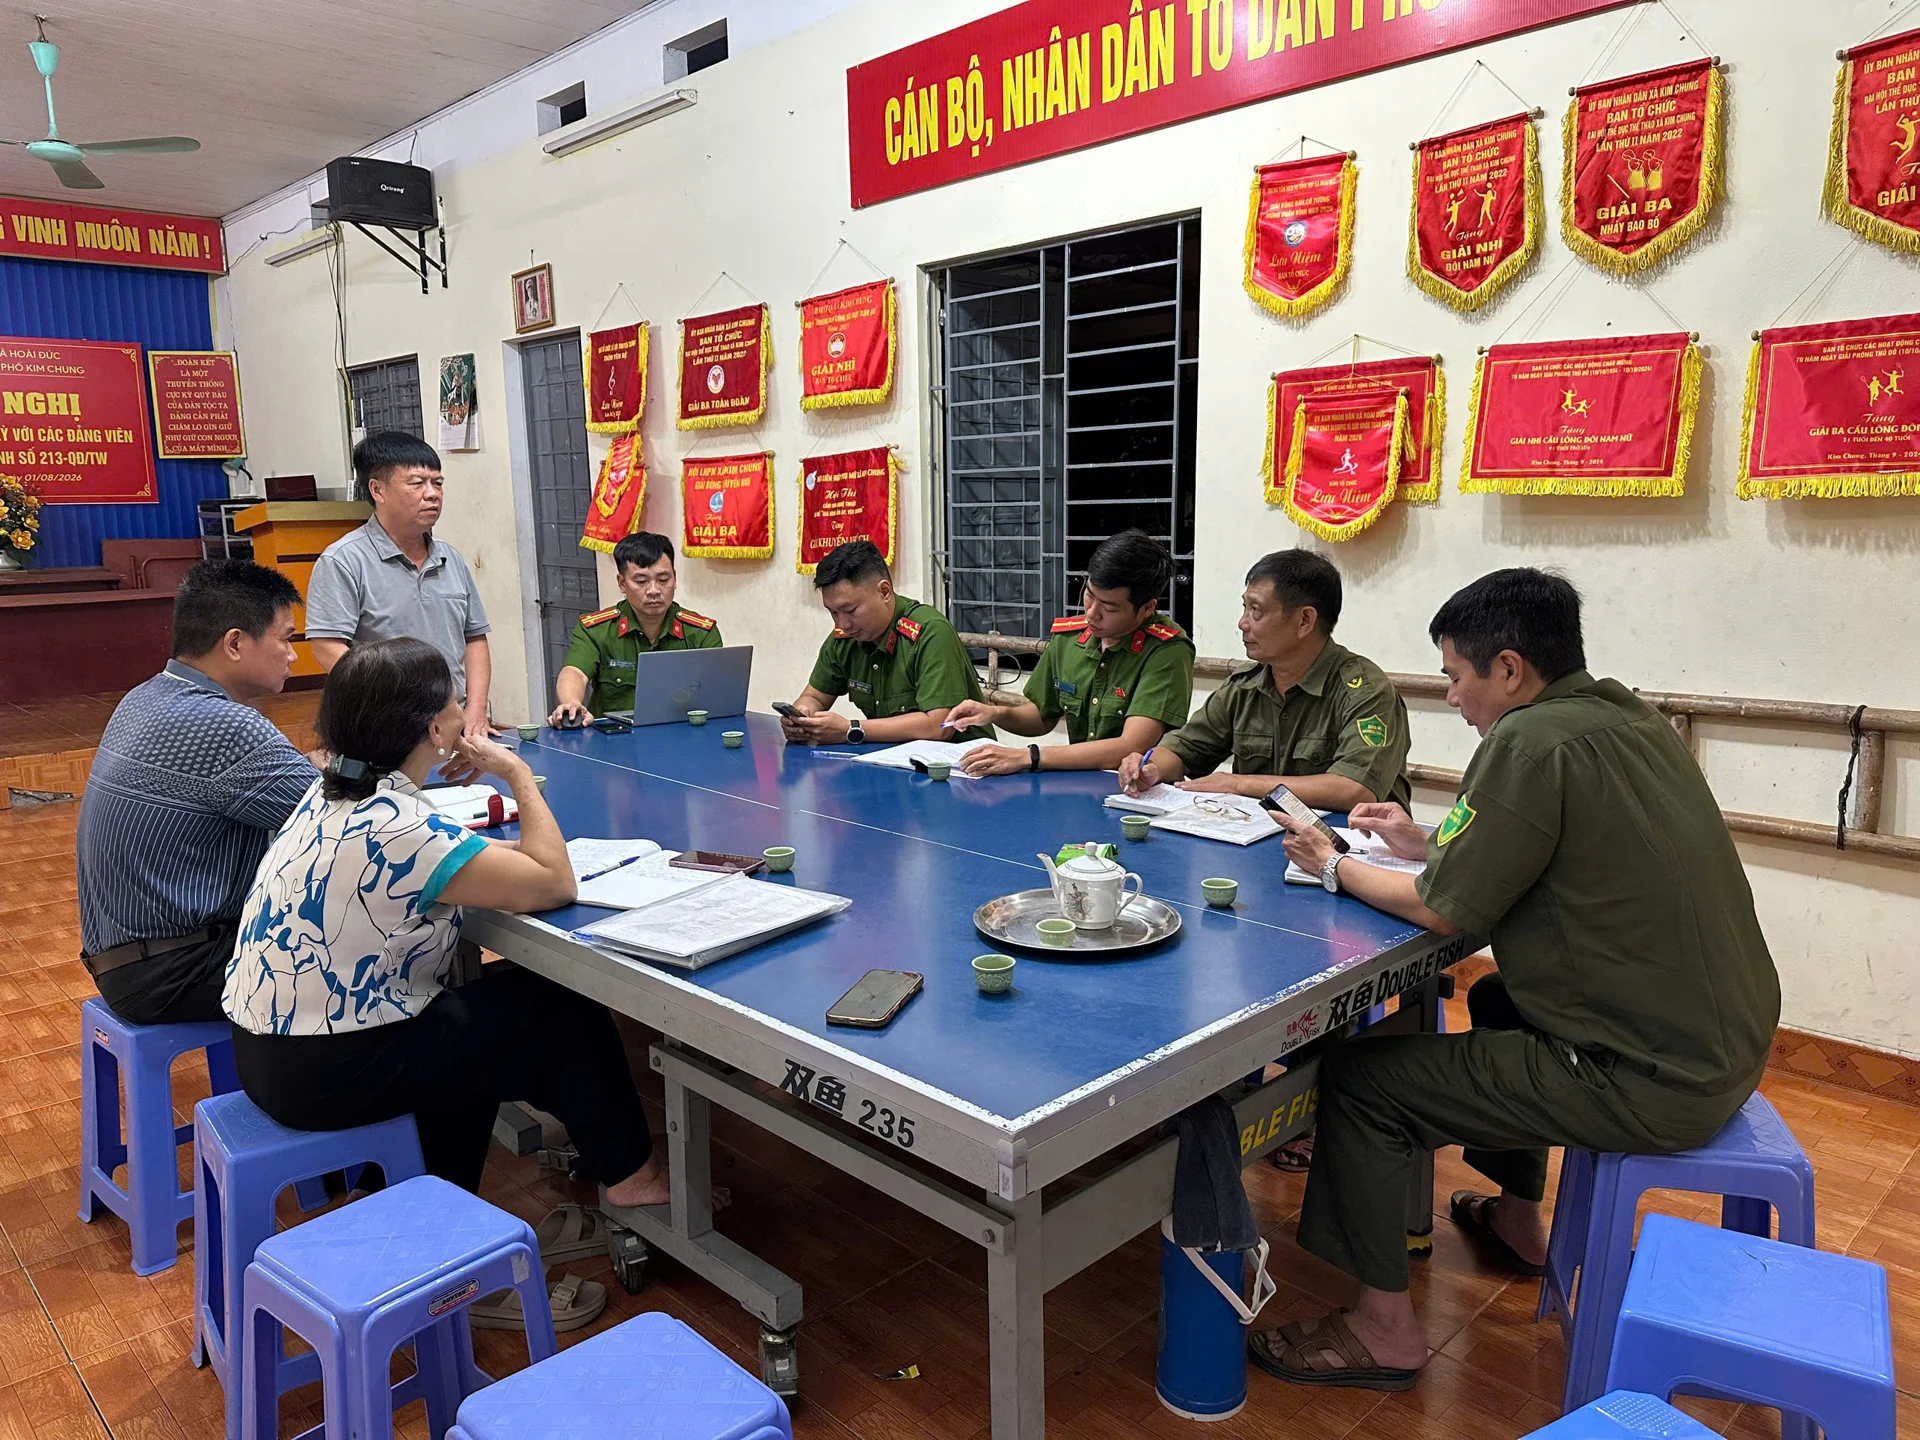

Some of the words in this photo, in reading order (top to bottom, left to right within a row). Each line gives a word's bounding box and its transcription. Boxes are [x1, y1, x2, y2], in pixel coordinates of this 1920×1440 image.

[1864, 61, 1874, 74] ỦY
[1876, 57, 1893, 70] BAN
[1896, 49, 1919, 65] NHÂN
[885, 76, 938, 165] CÁN
[947, 54, 993, 158] BỘ,
[1003, 26, 1090, 132] NHÂN
[1102, 0, 1175, 104] DÂN
[1887, 67, 1915, 84] BAN
[1598, 98, 1611, 108] BAN
[1613, 94, 1632, 106] NHÂN
[1634, 90, 1647, 102] DÂN
[1660, 86, 1672, 96] KIM
[1674, 80, 1699, 94] CHUNG
[1903, 83, 1917, 94] DỤC
[1607, 110, 1628, 123] BAN
[1632, 103, 1644, 118] TỔ
[1648, 100, 1676, 116] CHỨC
[1641, 120, 1655, 130] THAO
[1665, 116, 1675, 126] KIM
[1677, 112, 1696, 123] CHUNG
[1463, 142, 1474, 152] DÂN
[1484, 135, 1495, 146] KIM
[1497, 129, 1516, 143] CHUNG
[1615, 135, 1630, 148] THỨ
[1640, 131, 1660, 145] NĂM
[1663, 128, 1683, 140] 2022
[1442, 158, 1458, 170] BAN
[1462, 152, 1471, 163] TỔ
[1476, 146, 1499, 160] CHỨC
[1470, 173, 1487, 184] NĂM
[1489, 168, 1507, 179] 2022
[1877, 182, 1916, 206] GIẢI
[1596, 201, 1637, 219] GIẢI
[1644, 198, 1672, 212] BA
[1627, 220, 1644, 231] BAO
[11, 215, 67, 245] VINH
[75, 218, 140, 252] MUÔN
[149, 224, 199, 257] NĂM
[1441, 245, 1471, 259] GIẢI
[1476, 237, 1502, 253] NHÌ
[1463, 259, 1480, 269] NAM
[700, 336, 712, 346] BAN
[714, 332, 722, 343] TỔ
[725, 330, 742, 341] CHỨC
[10, 350, 36, 358] HOÀI
[39, 350, 60, 359] ĐỨC
[1821, 354, 1837, 362] NGÀY
[1852, 350, 1873, 359] PHÓNG
[1, 361, 23, 371] PHỐ
[47, 365, 85, 374] CHUNG
[192, 370, 208, 378] MỘT
[812, 361, 833, 376] GIẢI
[3, 392, 81, 421] NGHỊ
[168, 400, 182, 409] CỦA
[688, 400, 699, 411] GIẢI
[701, 401, 709, 409] BA
[711, 398, 729, 408] TOÀN
[731, 395, 750, 406] ĐOÀN
[13, 426, 33, 441] VỚI
[38, 426, 63, 442] CÁC
[67, 425, 102, 442] ĐẢNG
[105, 427, 133, 443] VIÊN
[1809, 426, 1829, 436] GIẢI
[1848, 425, 1867, 435] CẦU
[1870, 424, 1898, 433] LÔNG
[19, 447, 35, 464] SỐ
[40, 452, 108, 466] 213-QĐ/TW
[25, 474, 82, 482] 01/08/2026
[1340, 488, 1371, 506] Niệm
[693, 523, 716, 536] GIẢI
[720, 526, 737, 536] BA
[1324, 978, 1374, 1032] 双鱼
[1375, 952, 1435, 1006] DOUBLE
[1434, 937, 1465, 973] FISH
[1281, 1035, 1302, 1053] DOUBLE
[779, 1059, 846, 1117] 双鱼
[858, 1099, 915, 1147] 235
